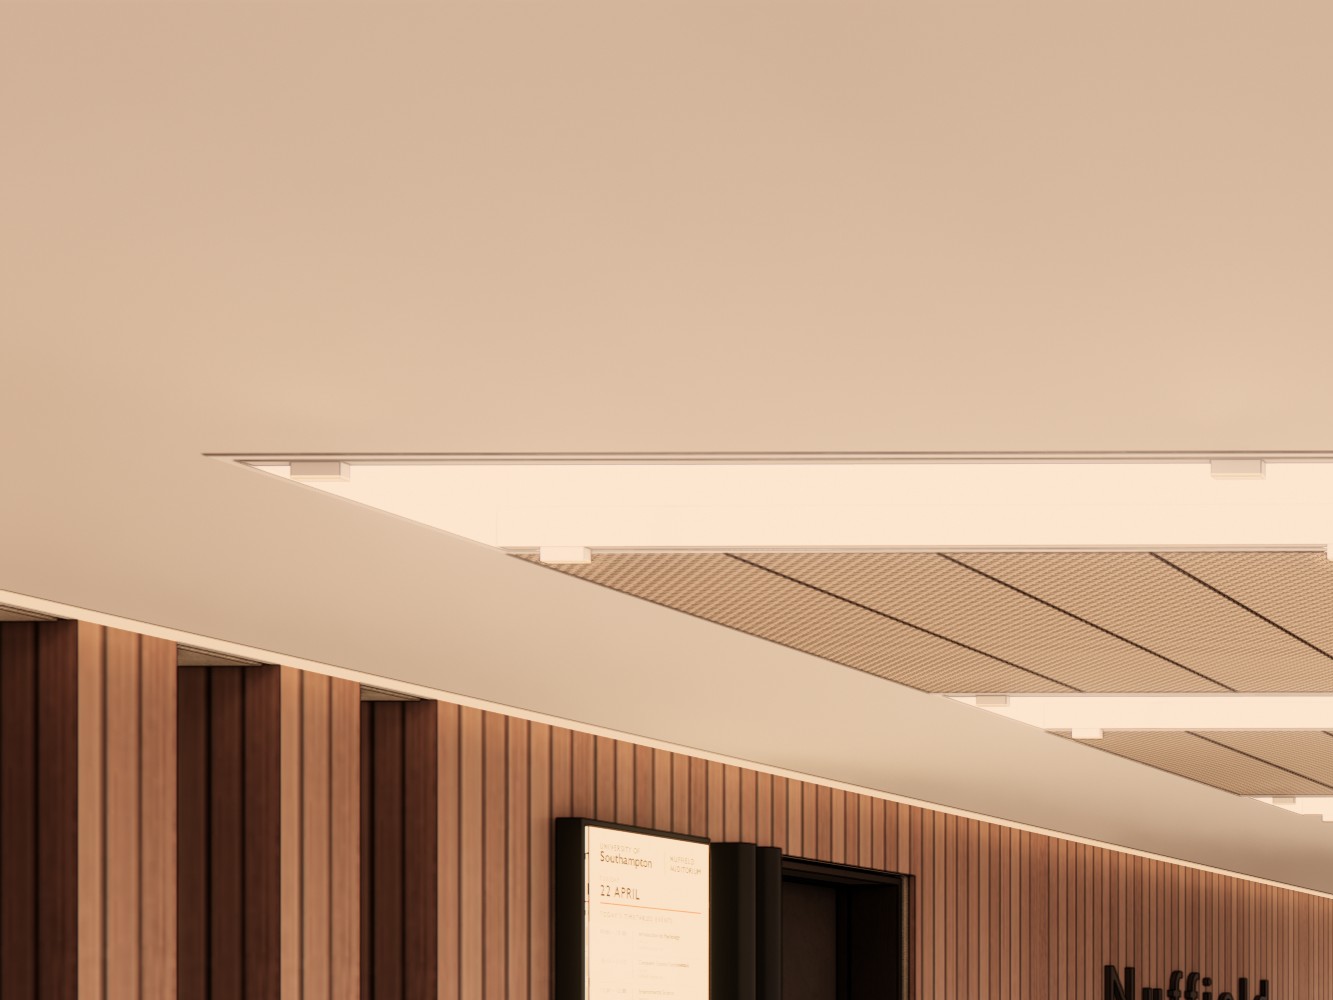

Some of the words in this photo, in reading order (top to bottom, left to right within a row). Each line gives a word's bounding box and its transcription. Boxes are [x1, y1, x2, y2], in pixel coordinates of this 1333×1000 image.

[600, 851, 653, 869] Southampton
[600, 884, 611, 897] 22
[614, 886, 640, 900] APRIL
